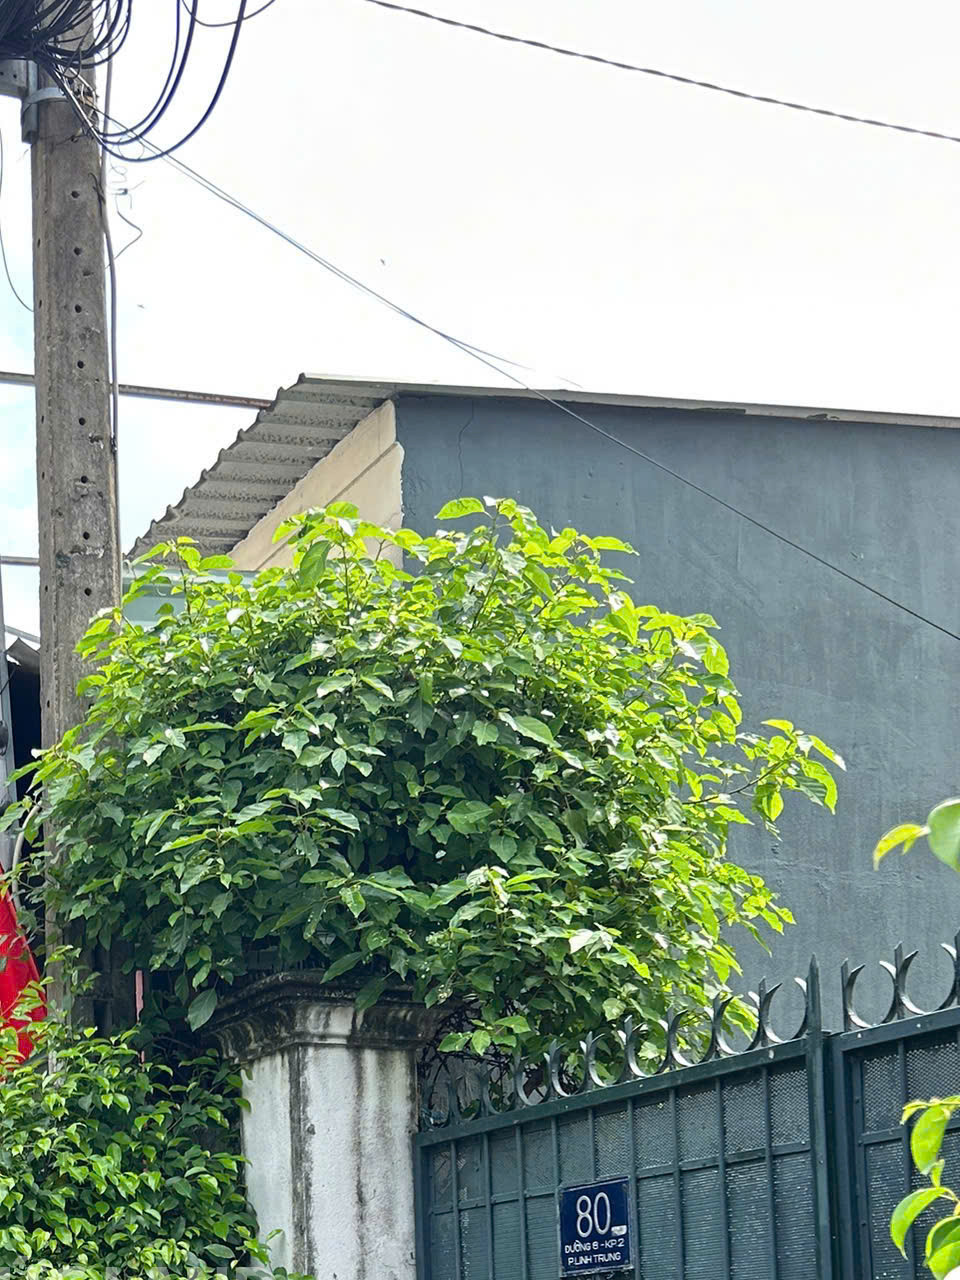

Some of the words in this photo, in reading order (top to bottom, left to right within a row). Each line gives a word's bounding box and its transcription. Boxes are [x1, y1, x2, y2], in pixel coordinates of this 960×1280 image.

[576, 1192, 611, 1238] 80
[592, 1241, 599, 1250] 8
[593, 1252, 621, 1263] TRUNG
